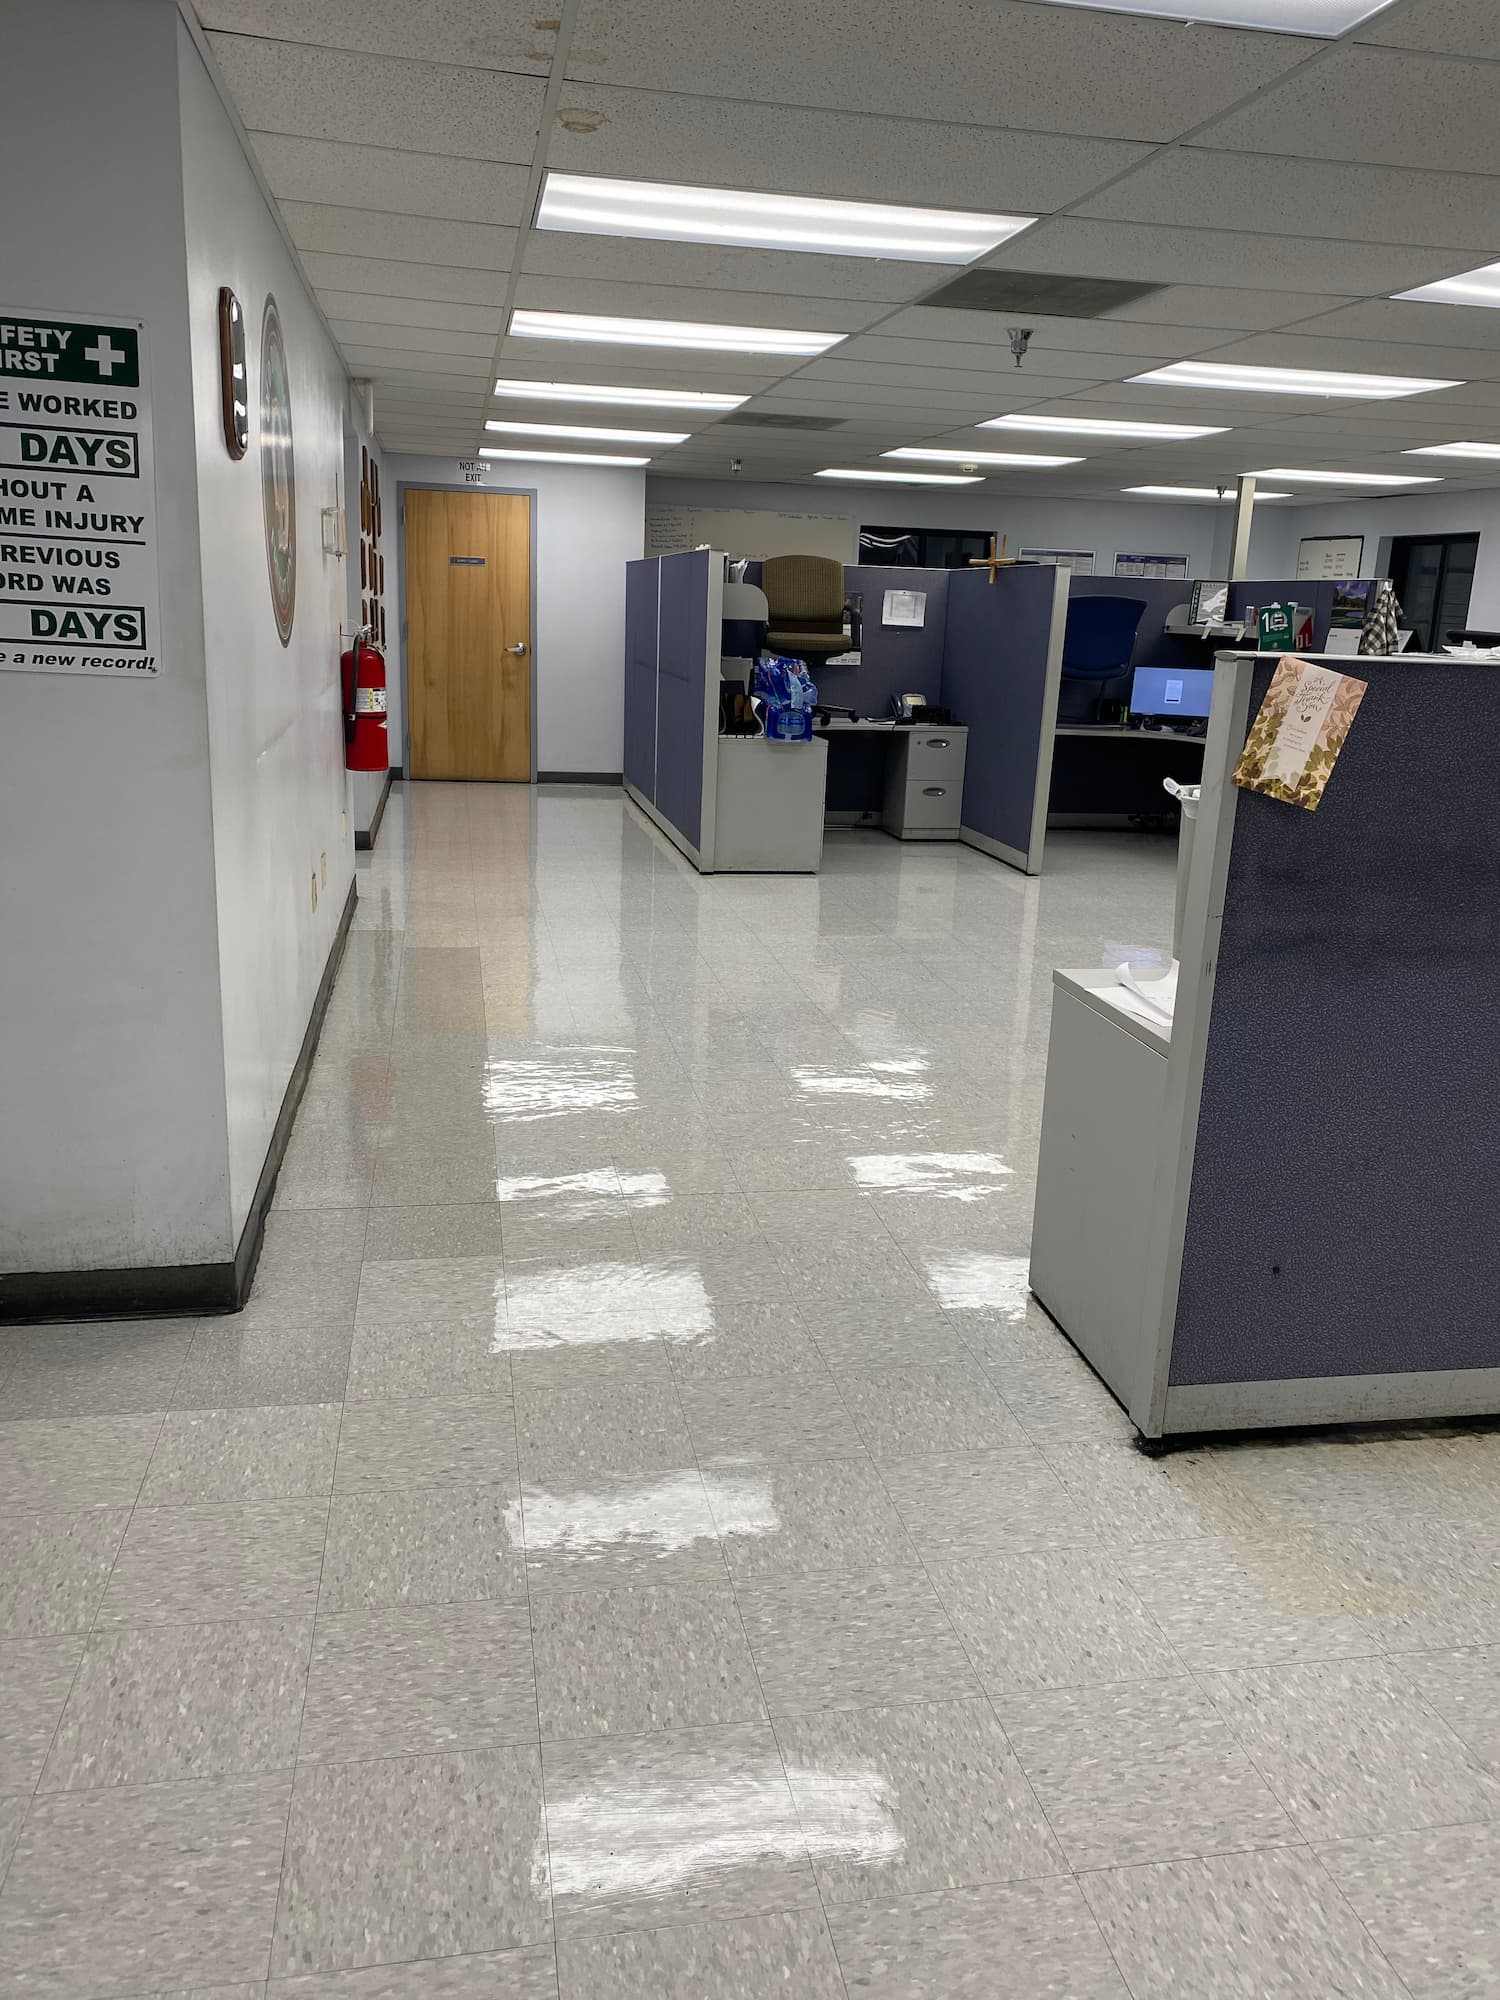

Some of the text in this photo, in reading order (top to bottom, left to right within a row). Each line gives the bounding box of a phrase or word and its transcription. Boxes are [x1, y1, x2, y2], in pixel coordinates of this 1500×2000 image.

[18, 392, 138, 420] WORKED
[21, 432, 132, 469] DAYS
[459, 462, 475, 471] NOT
[466, 473, 481, 482] EXIT
[76, 484, 96, 503] A
[45, 510, 145, 534] INJURY
[1, 544, 121, 569] REVIOUS
[52, 575, 112, 596] WAS
[31, 609, 139, 642] DAYS
[13, 653, 25, 664] a
[32, 654, 76, 667] new
[81, 656, 155, 671] record!
[1300, 680, 1335, 693] Special
[1294, 692, 1329, 705] Thank
